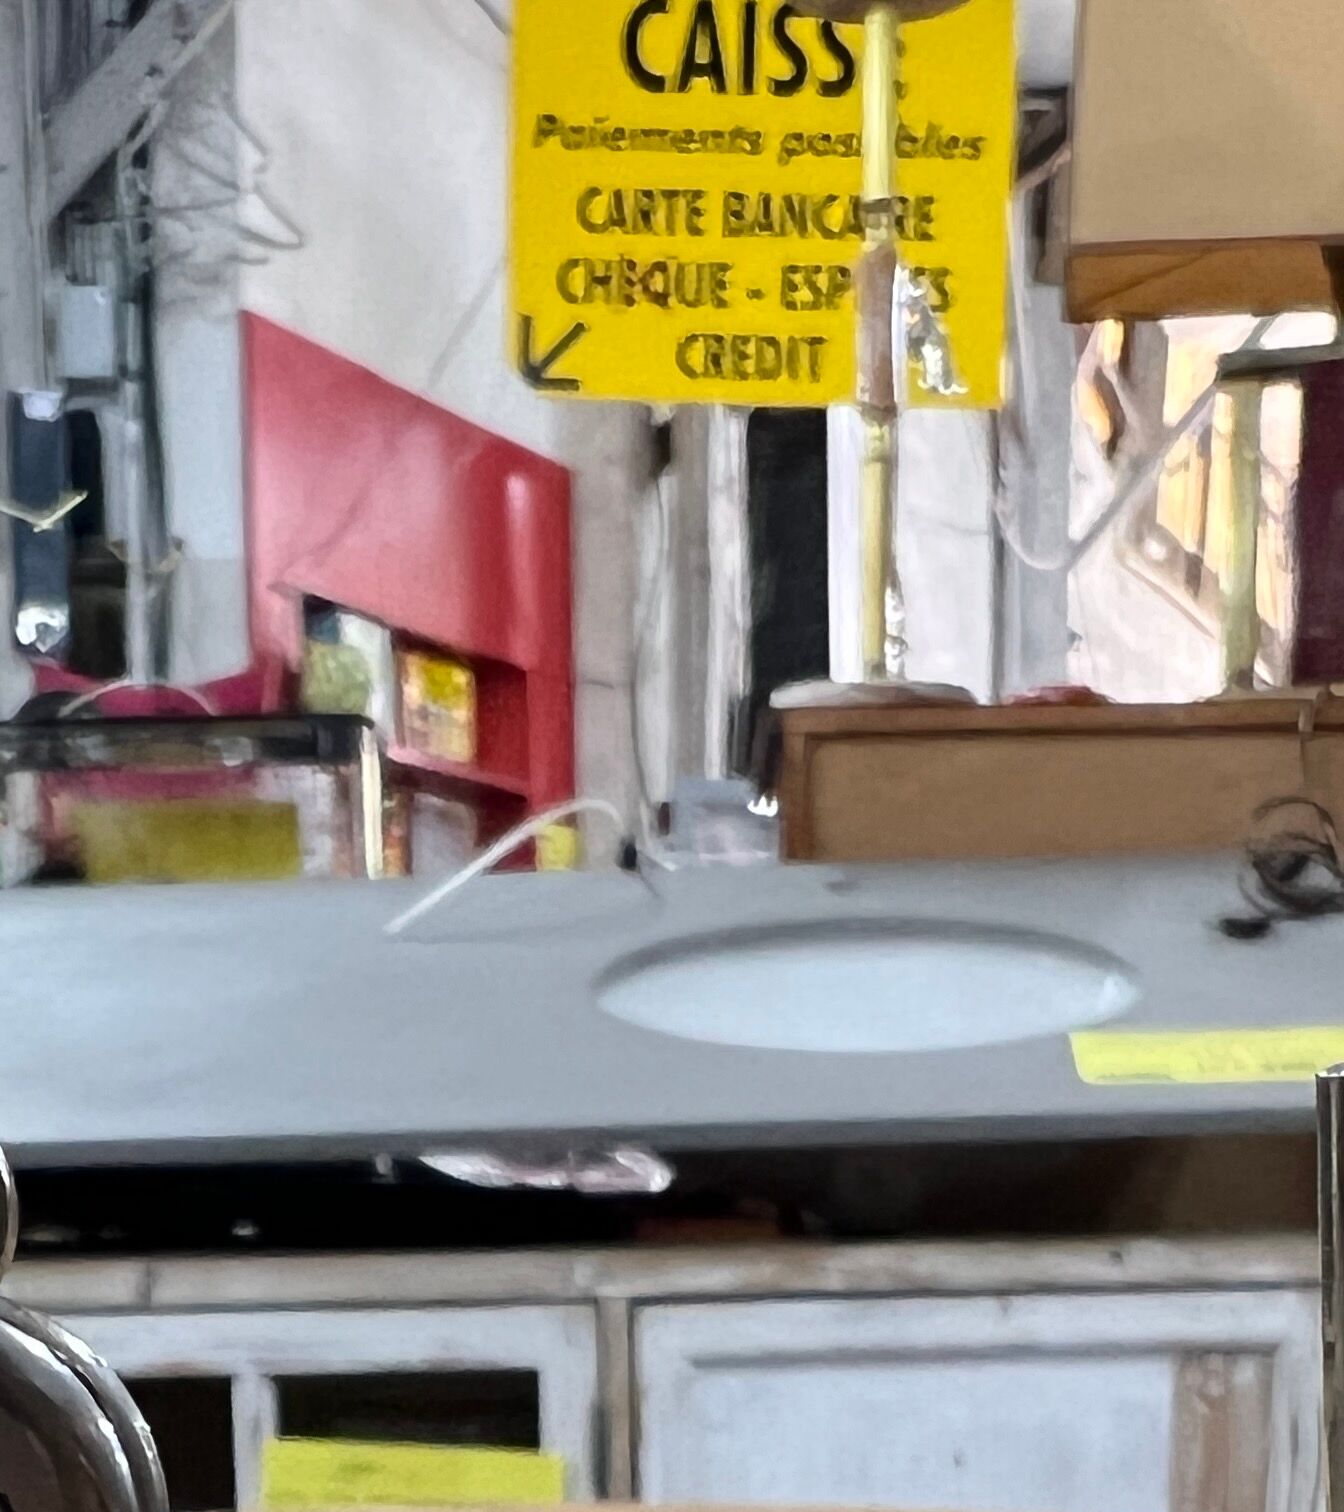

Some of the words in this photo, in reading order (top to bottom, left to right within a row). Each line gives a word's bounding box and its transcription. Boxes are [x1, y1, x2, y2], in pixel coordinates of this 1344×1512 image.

[622, 0, 906, 97] CAISS
[576, 187, 706, 237] CARTE
[675, 334, 828, 382] CREDIT
